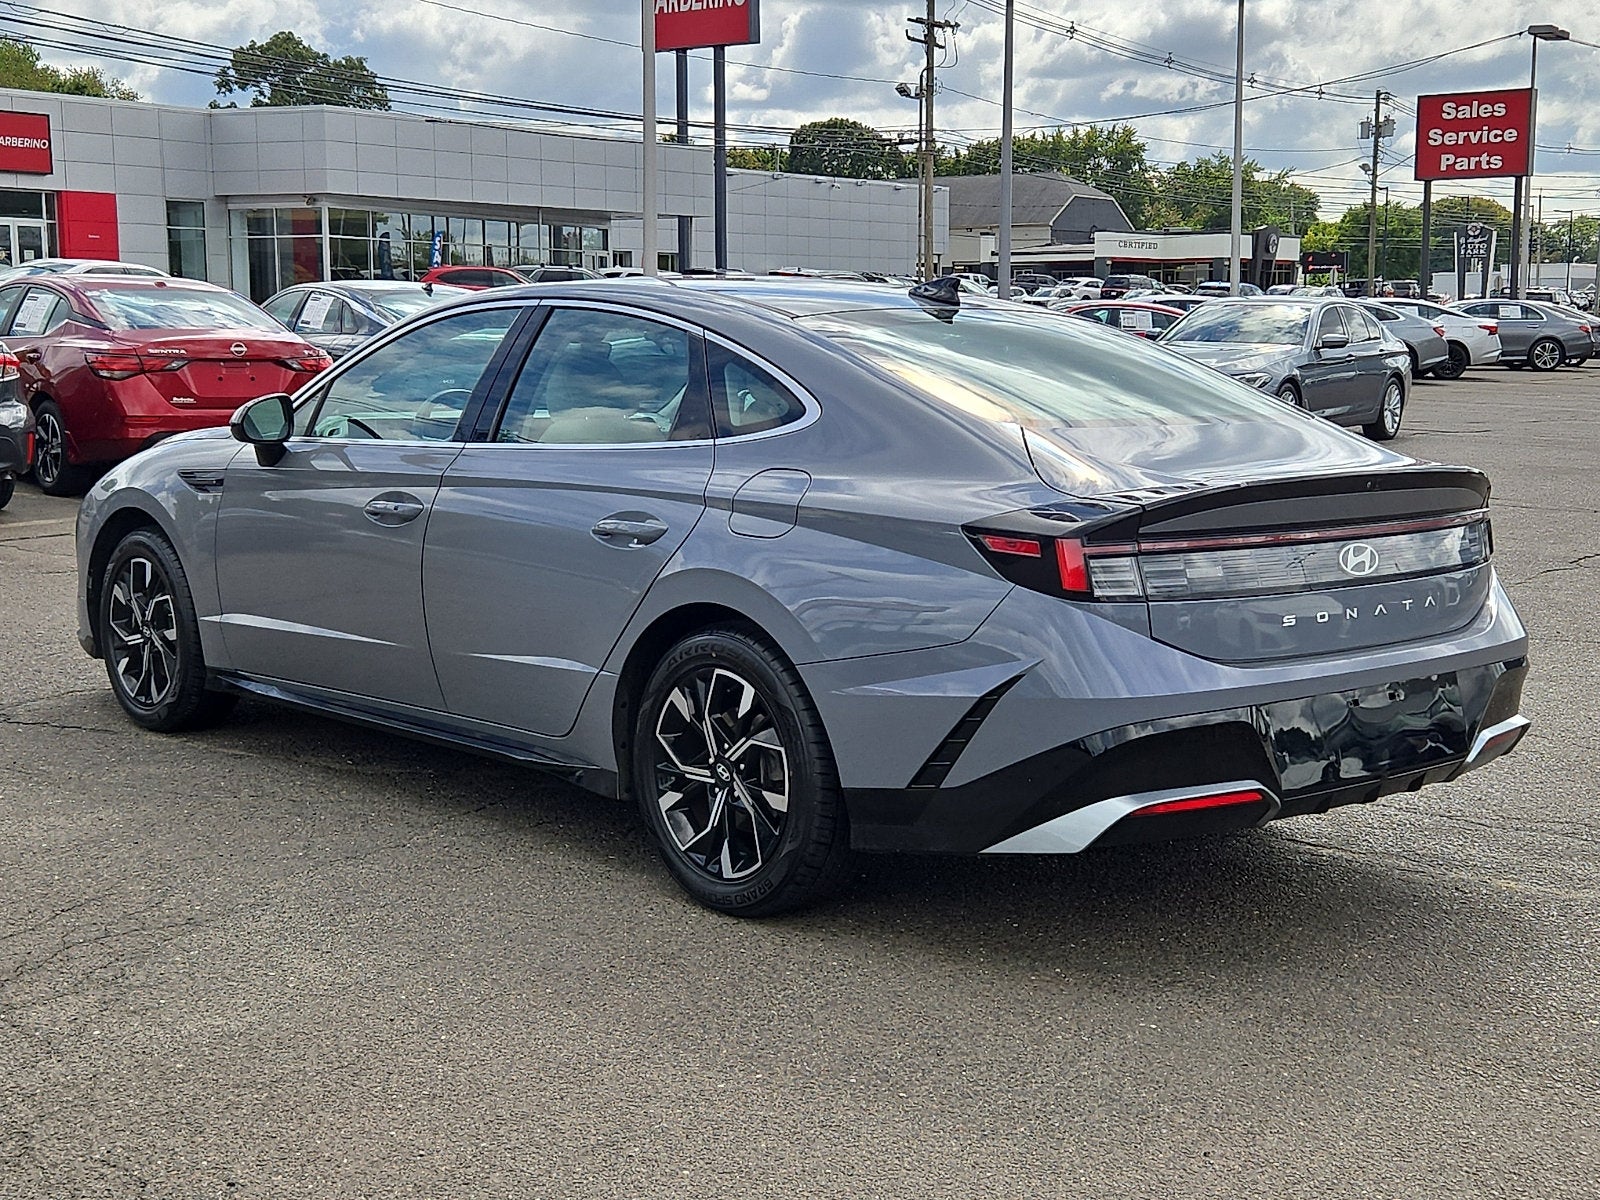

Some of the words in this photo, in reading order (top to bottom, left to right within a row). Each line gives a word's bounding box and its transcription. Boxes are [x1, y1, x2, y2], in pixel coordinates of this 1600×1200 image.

[1441, 100, 1507, 120] Sales
[1427, 126, 1518, 146] Service
[1440, 152, 1503, 171] Parts
[1118, 239, 1158, 250] CERTIFIED
[1282, 595, 1436, 628] SONATA
